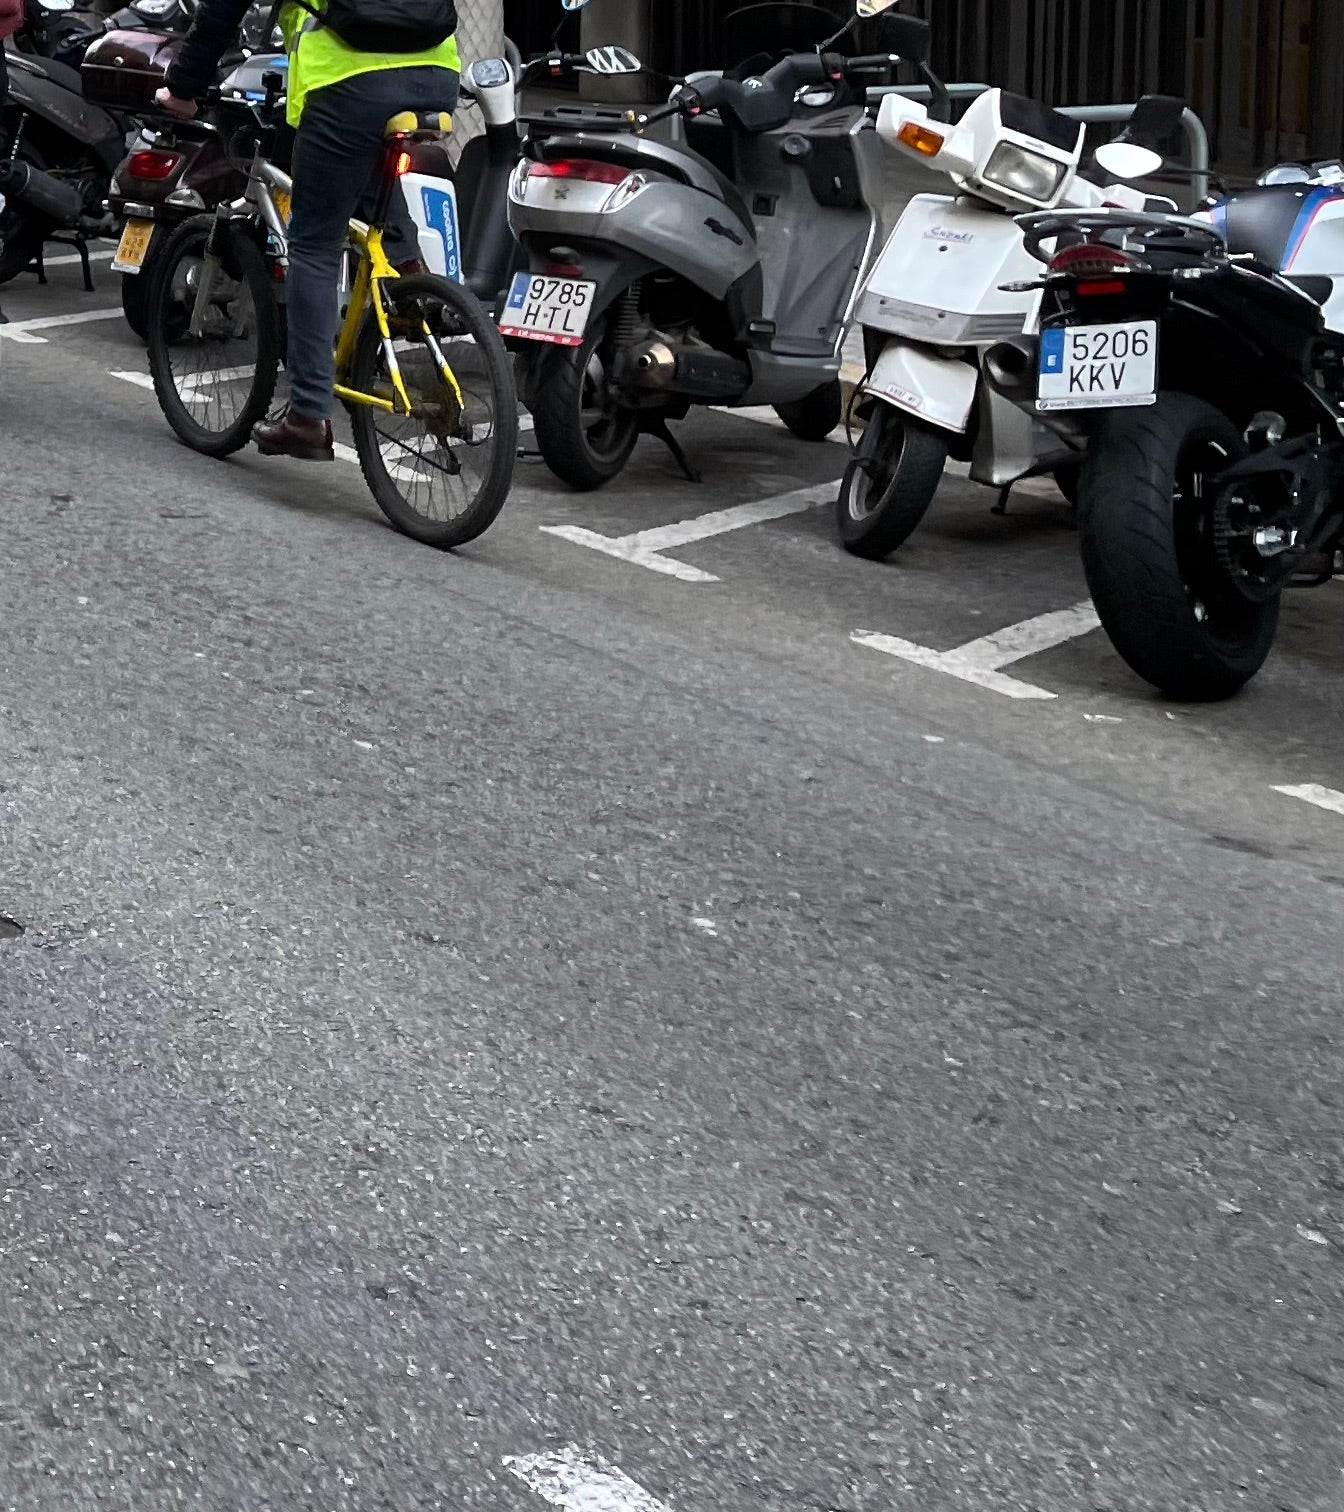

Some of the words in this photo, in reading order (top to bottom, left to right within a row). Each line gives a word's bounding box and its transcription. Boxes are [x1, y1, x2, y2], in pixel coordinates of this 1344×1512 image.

[529, 278, 589, 307] 9785
[522, 303, 576, 333] HTL
[1072, 329, 1149, 361] 5206
[1069, 361, 1126, 393] KKV
